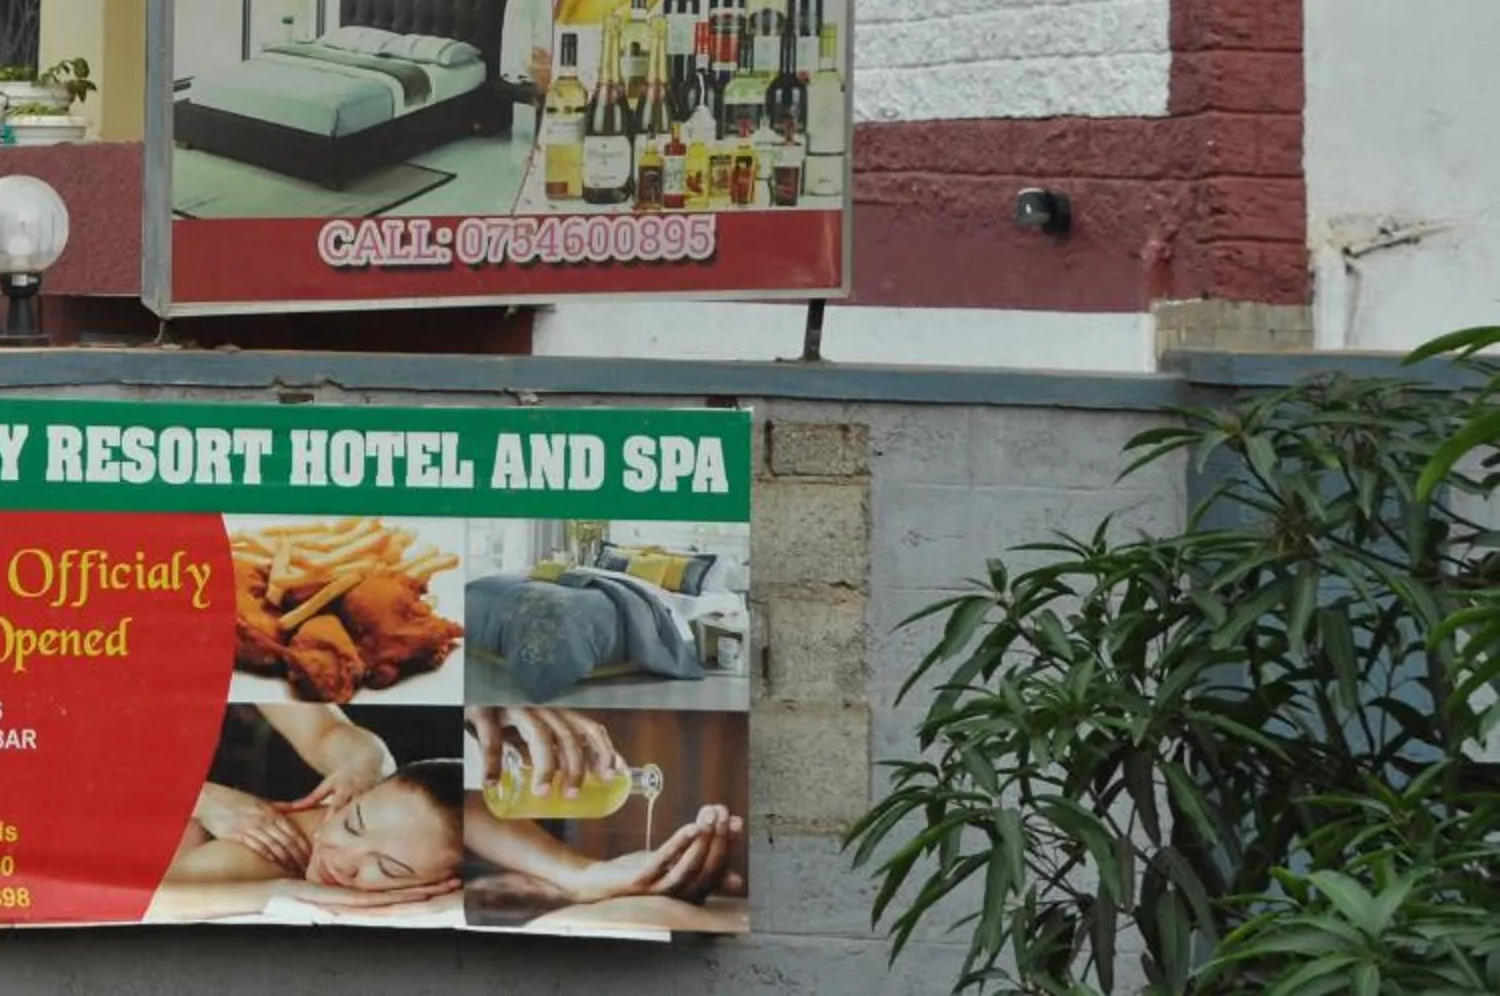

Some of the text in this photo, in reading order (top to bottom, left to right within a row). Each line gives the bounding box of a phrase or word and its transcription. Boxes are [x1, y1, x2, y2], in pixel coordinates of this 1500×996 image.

[318, 213, 716, 266] CALL: 0754600895
[46, 424, 273, 485] RESORT
[289, 428, 474, 489] HOTEL
[490, 432, 606, 492] AND
[622, 435, 729, 493] SPA
[7, 547, 212, 608] Officialy
